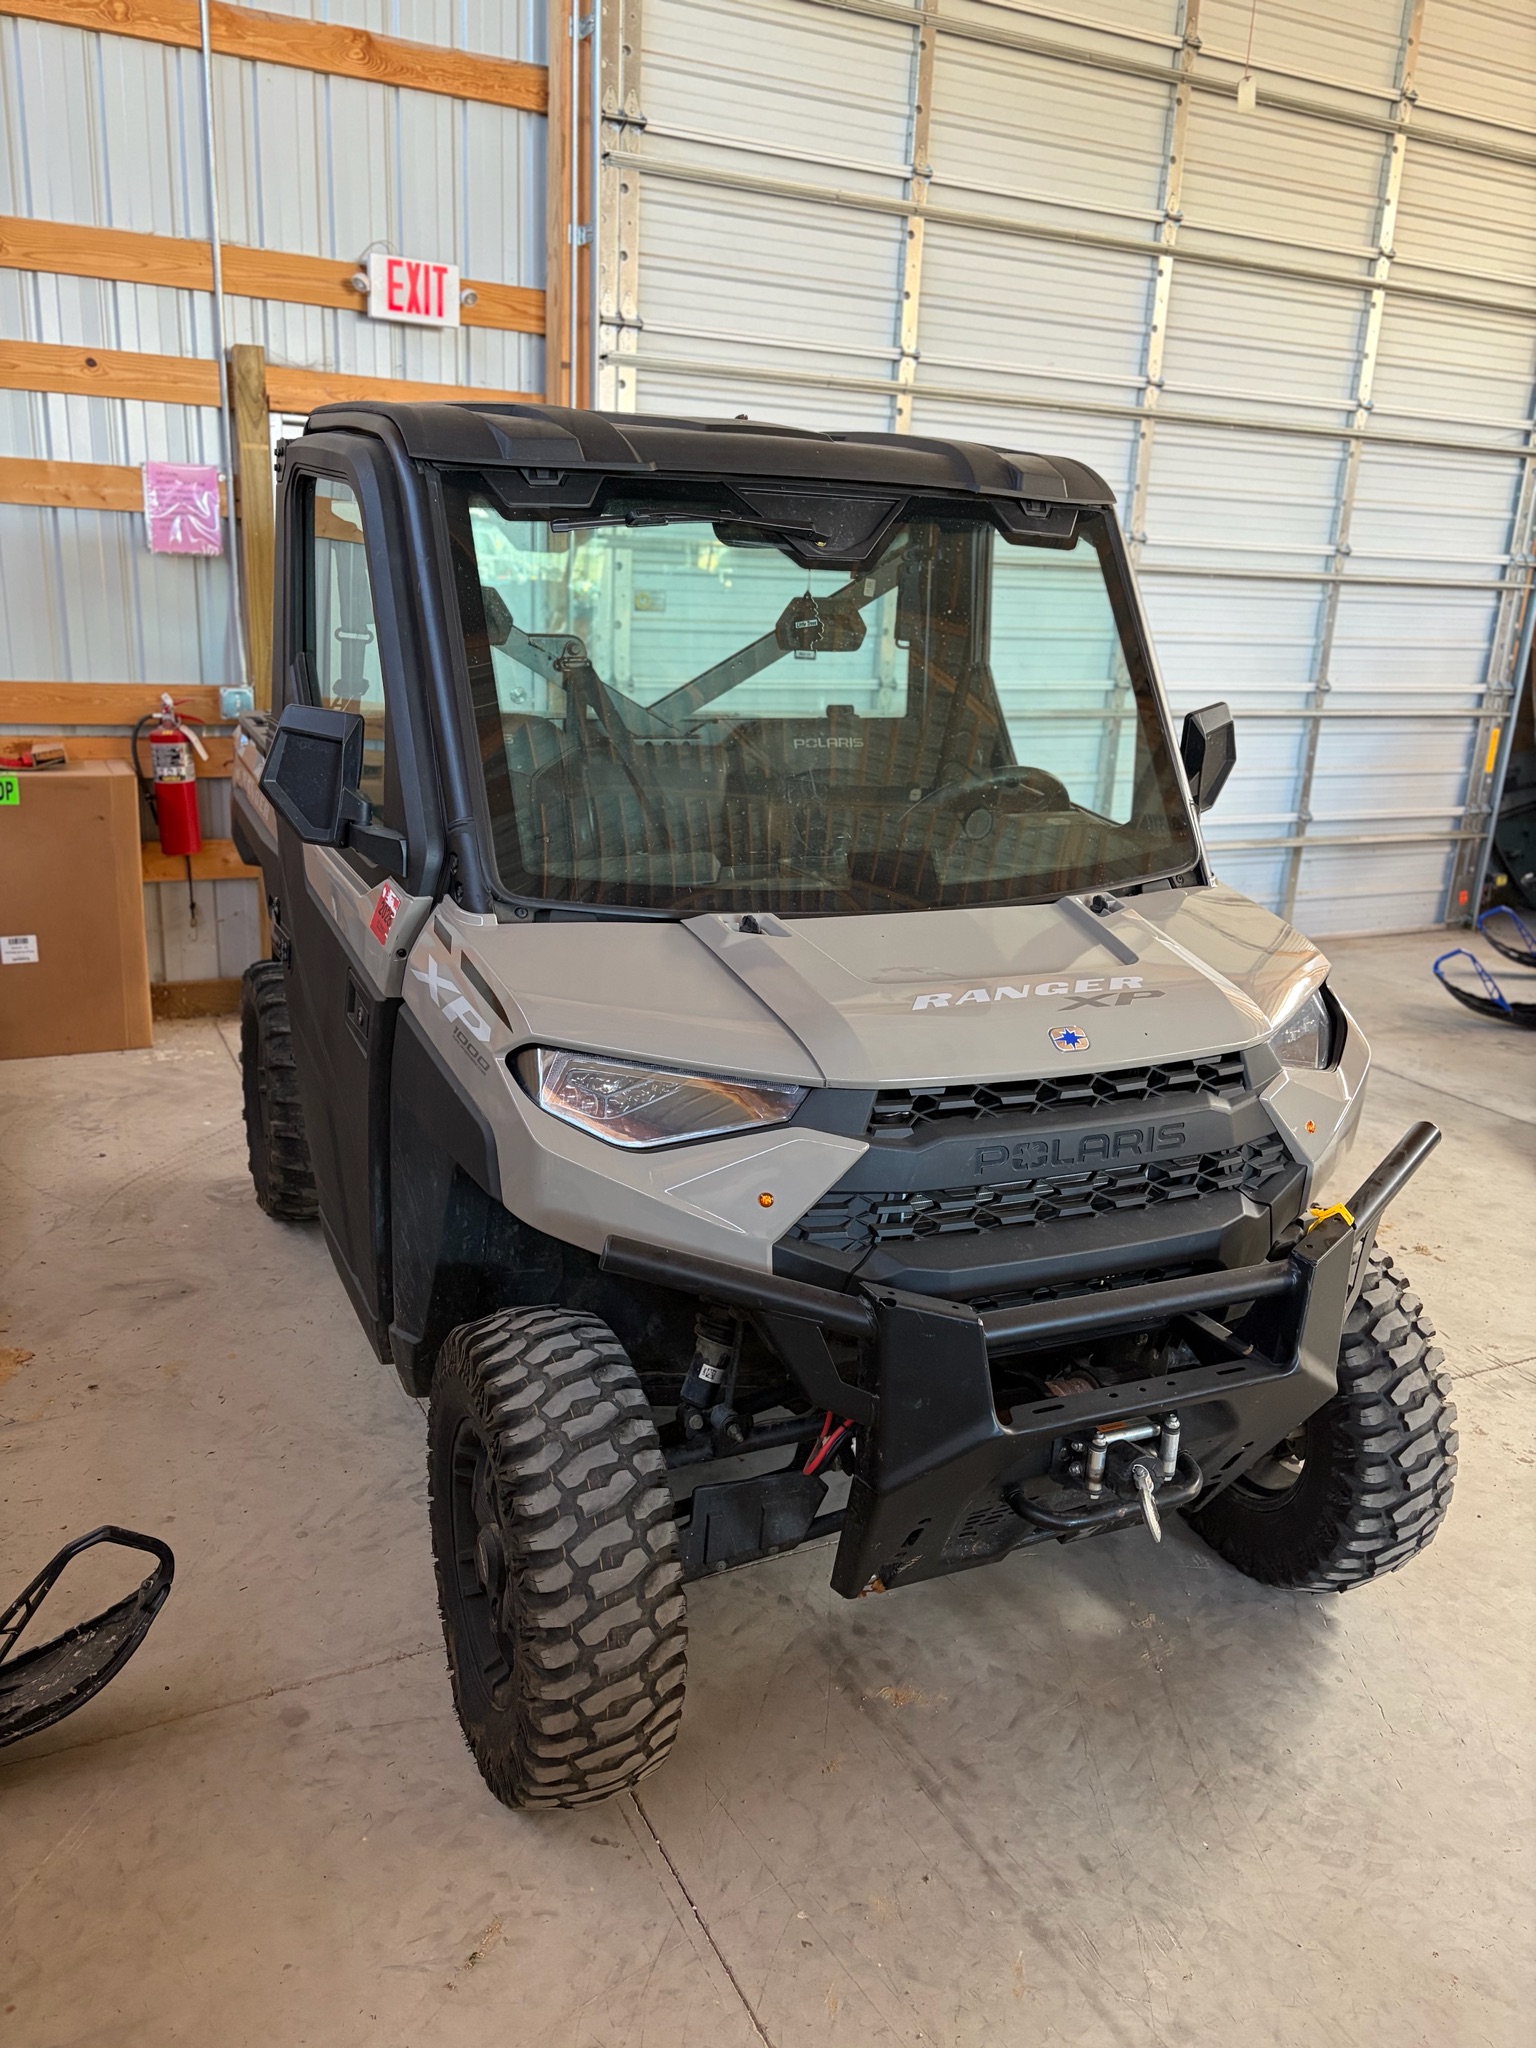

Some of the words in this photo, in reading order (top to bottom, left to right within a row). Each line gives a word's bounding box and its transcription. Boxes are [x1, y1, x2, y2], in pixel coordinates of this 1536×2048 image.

[387, 258, 448, 318] EXIT
[793, 737, 864, 749] POLARIS
[410, 953, 491, 1042] XP
[912, 976, 1144, 1011] RANGER
[1057, 989, 1166, 1012] XP
[453, 1025, 491, 1072] 1000
[974, 1122, 1186, 1177] POLARIS
